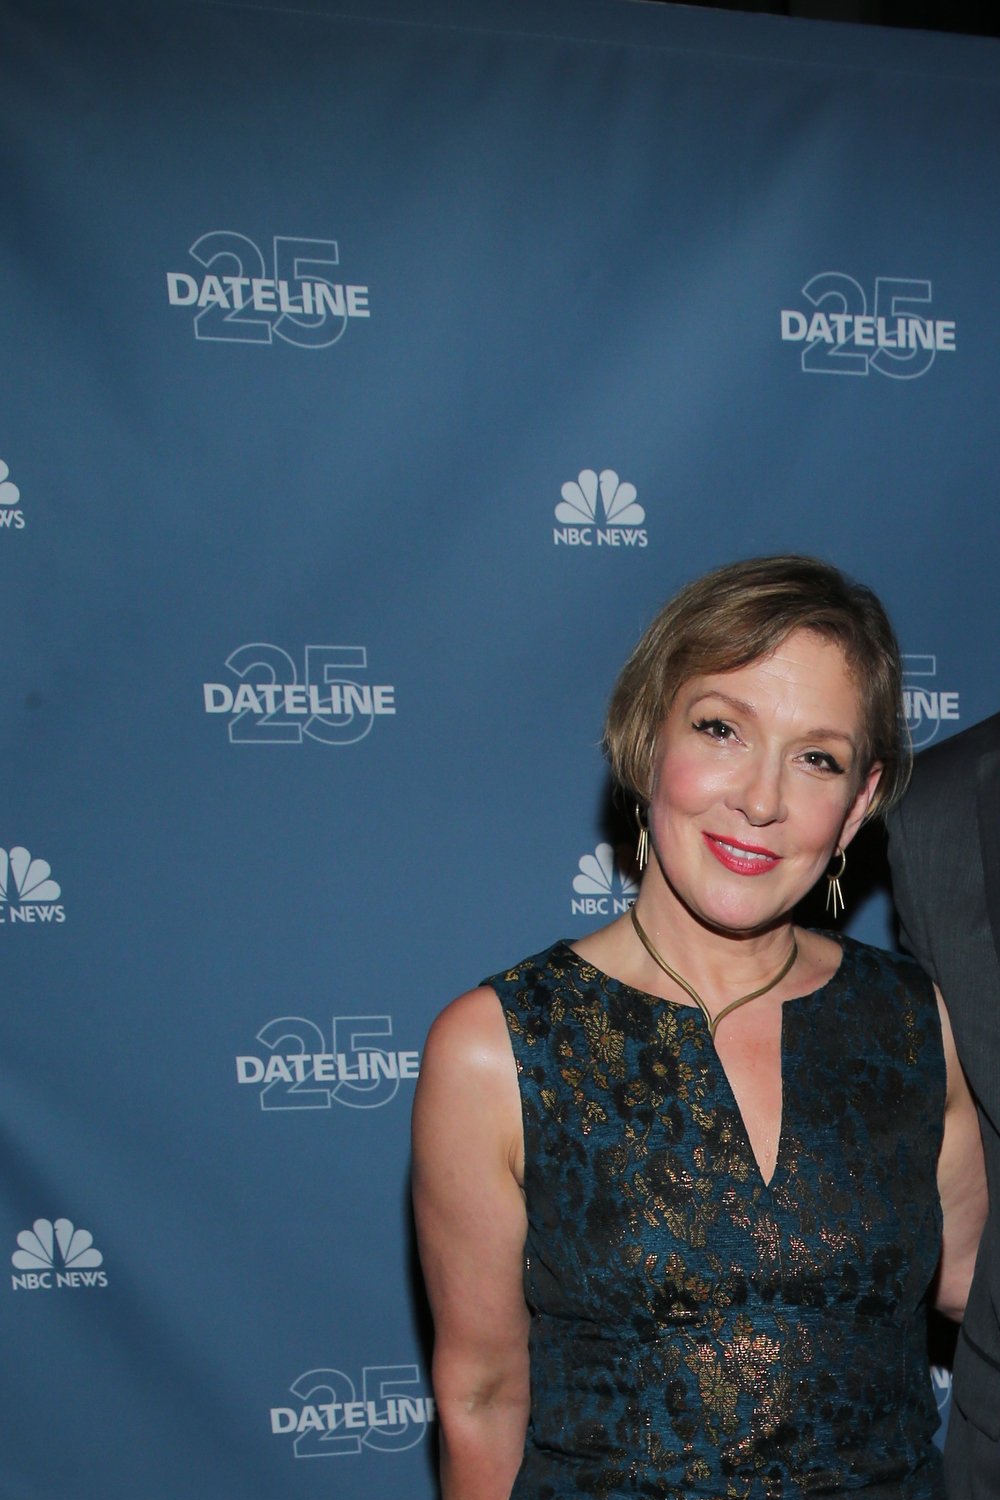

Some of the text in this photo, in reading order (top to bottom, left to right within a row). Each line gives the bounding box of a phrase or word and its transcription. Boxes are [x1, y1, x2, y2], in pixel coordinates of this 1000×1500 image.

[166, 272, 371, 318] DATELINE
[189, 231, 348, 349] 25
[780, 310, 956, 351] DATELINE
[801, 271, 936, 380] 25
[553, 528, 648, 548] NBC NEWS
[203, 683, 396, 715] DATELINE
[225, 643, 375, 746] 25
[10, 905, 66, 923] NEWS
[571, 898, 608, 915] NBC
[236, 1051, 420, 1084] DATELINE
[256, 1016, 400, 1111] 25
[11, 1271, 108, 1291] NBC NEWS
[290, 1364, 428, 1459] 25
